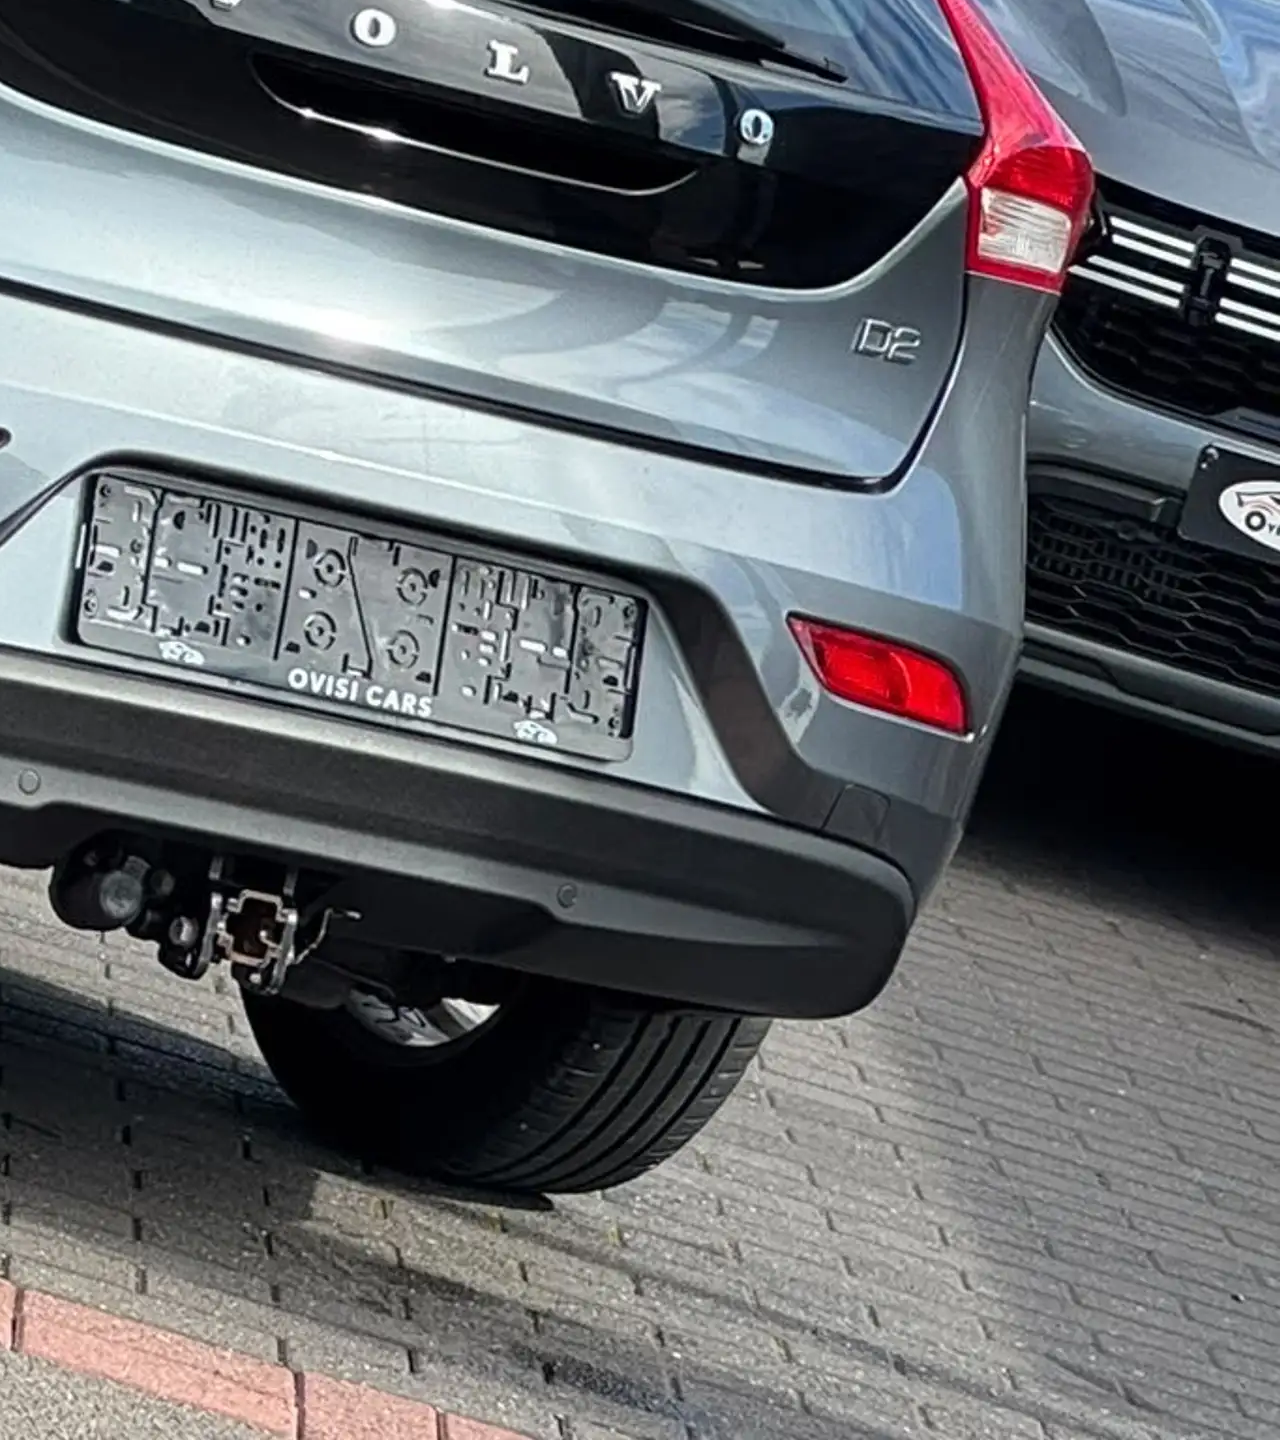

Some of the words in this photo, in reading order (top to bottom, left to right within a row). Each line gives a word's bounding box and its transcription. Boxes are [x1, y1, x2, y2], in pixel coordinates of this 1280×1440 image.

[851, 318, 921, 364] D2
[287, 666, 360, 703] OVISI
[365, 684, 434, 718] CARS
